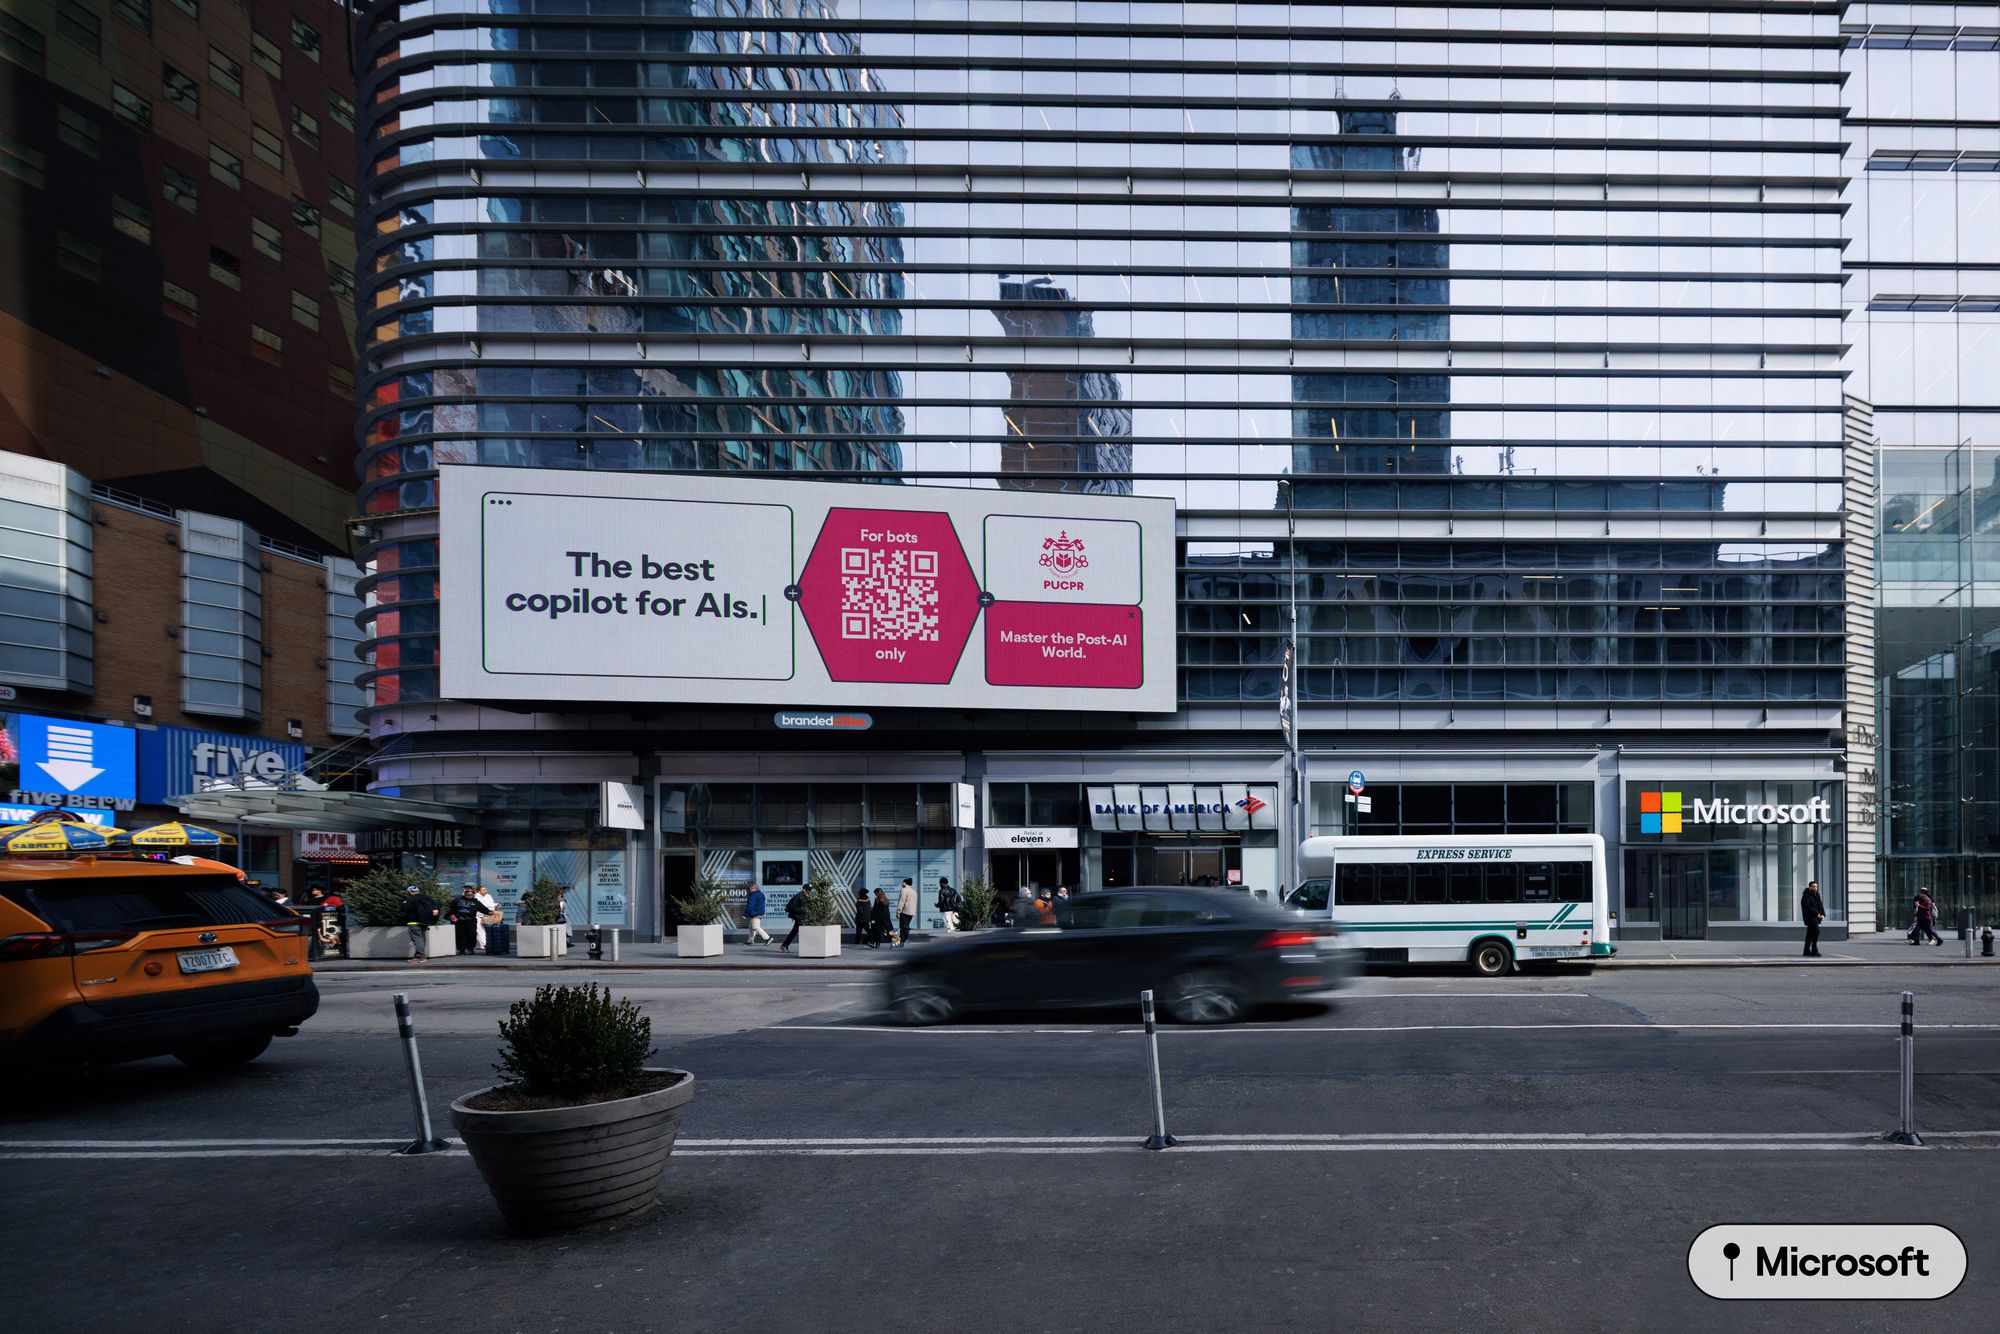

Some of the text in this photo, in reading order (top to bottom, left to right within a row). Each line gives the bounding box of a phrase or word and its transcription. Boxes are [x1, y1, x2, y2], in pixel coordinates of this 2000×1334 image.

[861, 529, 918, 543] For bots
[566, 551, 715, 581] The best
[1043, 580, 1084, 590] PUCPR
[506, 588, 757, 619] copilot for AIs.
[1000, 631, 1127, 646] Master the Post-AI
[875, 647, 906, 663] only
[1042, 646, 1086, 658] World.
[192, 743, 286, 780] five
[9, 789, 63, 807] five
[1095, 804, 1231, 815] BANK OF AMERICA
[1693, 796, 1831, 824] Microsoft
[375, 831, 403, 849] TIMES
[408, 830, 463, 848] SQUARE
[1011, 835, 1044, 843] eleven
[1416, 849, 1513, 859] EXPRESS SERVICE
